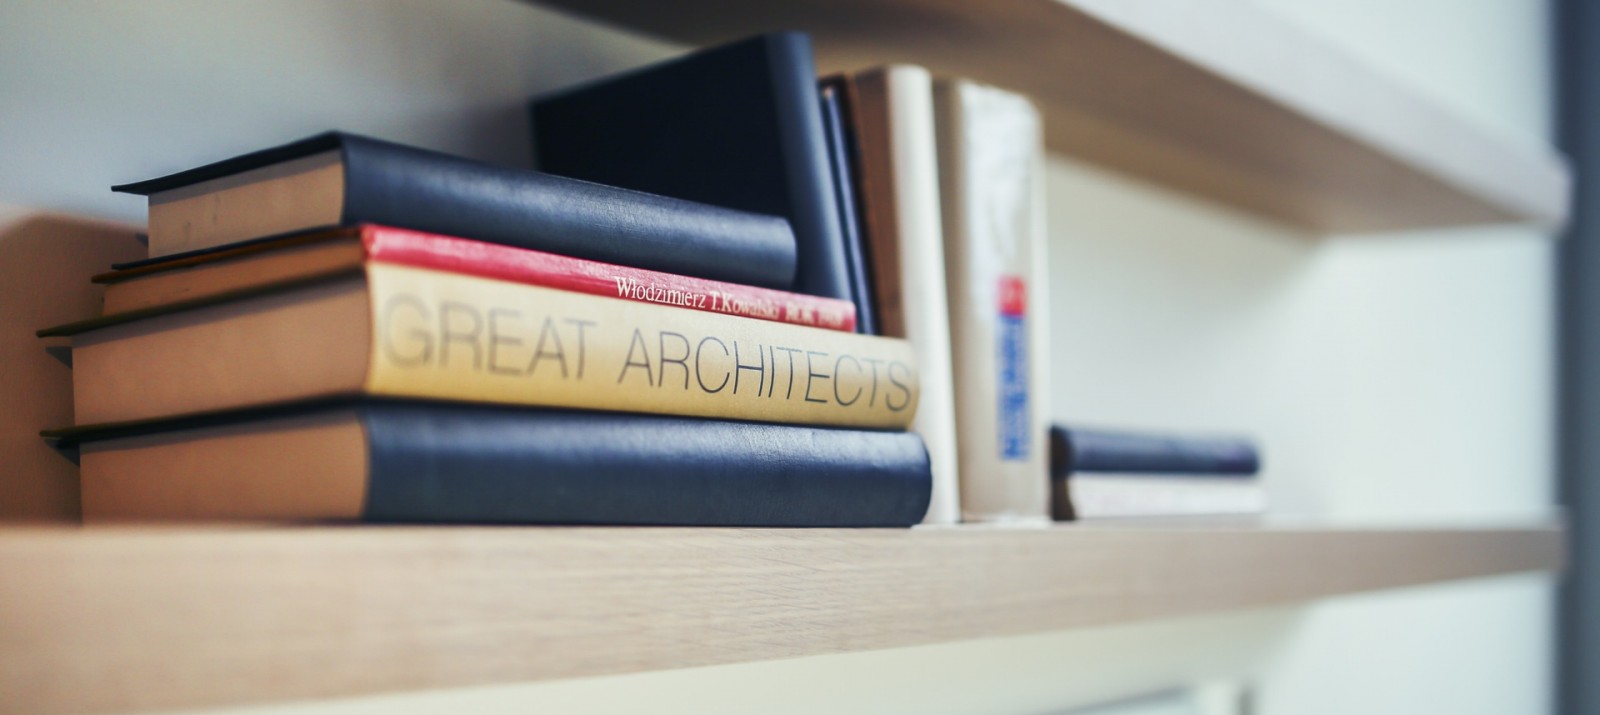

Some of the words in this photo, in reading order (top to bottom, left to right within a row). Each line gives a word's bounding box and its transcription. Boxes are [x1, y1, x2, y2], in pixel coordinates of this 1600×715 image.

[614, 276, 705, 309] Włodzimierz
[381, 292, 598, 381] GREAT
[617, 328, 913, 412] ARCHITECTS
